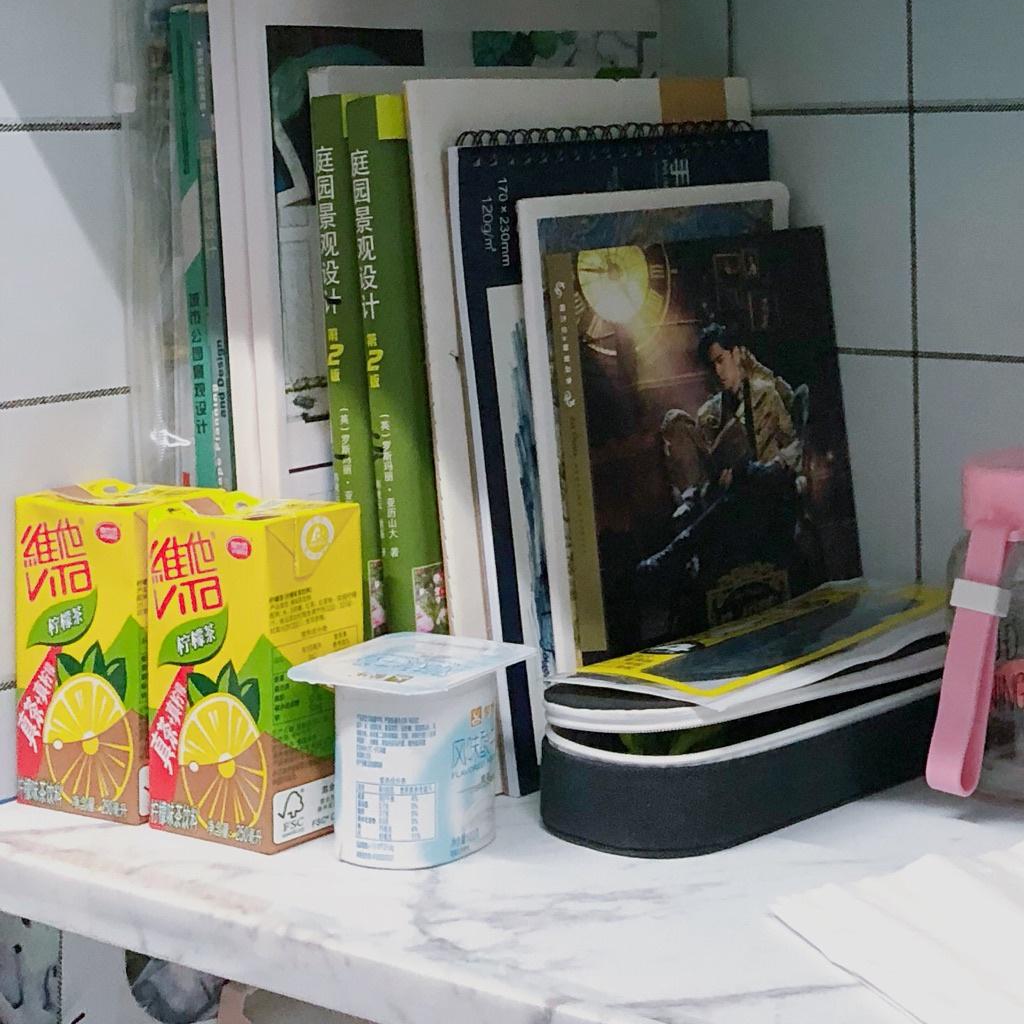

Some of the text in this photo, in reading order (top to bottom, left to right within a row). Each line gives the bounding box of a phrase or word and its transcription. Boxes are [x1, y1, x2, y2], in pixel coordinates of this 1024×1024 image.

[350, 149, 380, 321] 庭园景观设计
[500, 216, 511, 268] 230mm
[216, 339, 227, 418] and Design
[48, 605, 84, 636] 柠檬茶
[176, 621, 216, 656] 柠檬茶
[283, 817, 305, 832] FSC
